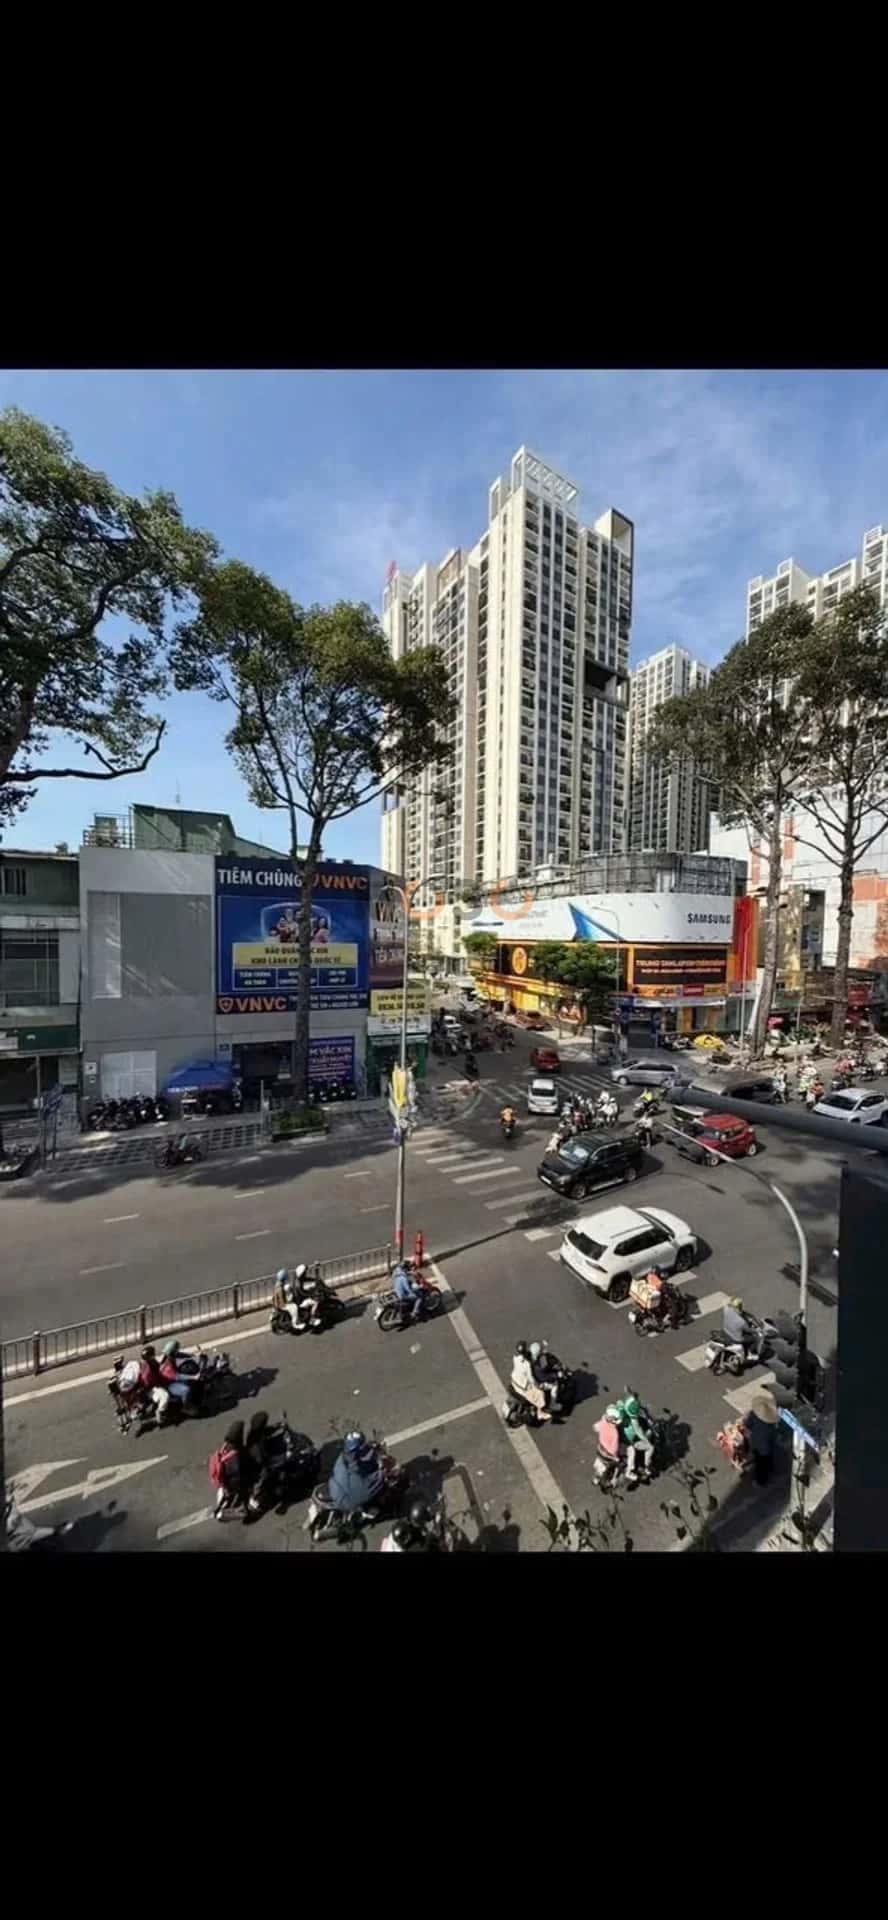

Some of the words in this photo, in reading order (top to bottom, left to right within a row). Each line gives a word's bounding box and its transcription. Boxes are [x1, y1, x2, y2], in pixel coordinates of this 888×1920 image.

[217, 866, 253, 885] TIÊM
[321, 874, 369, 889] VNVC
[687, 912, 731, 925] SAMSUNG
[236, 996, 287, 1011] VNVC
